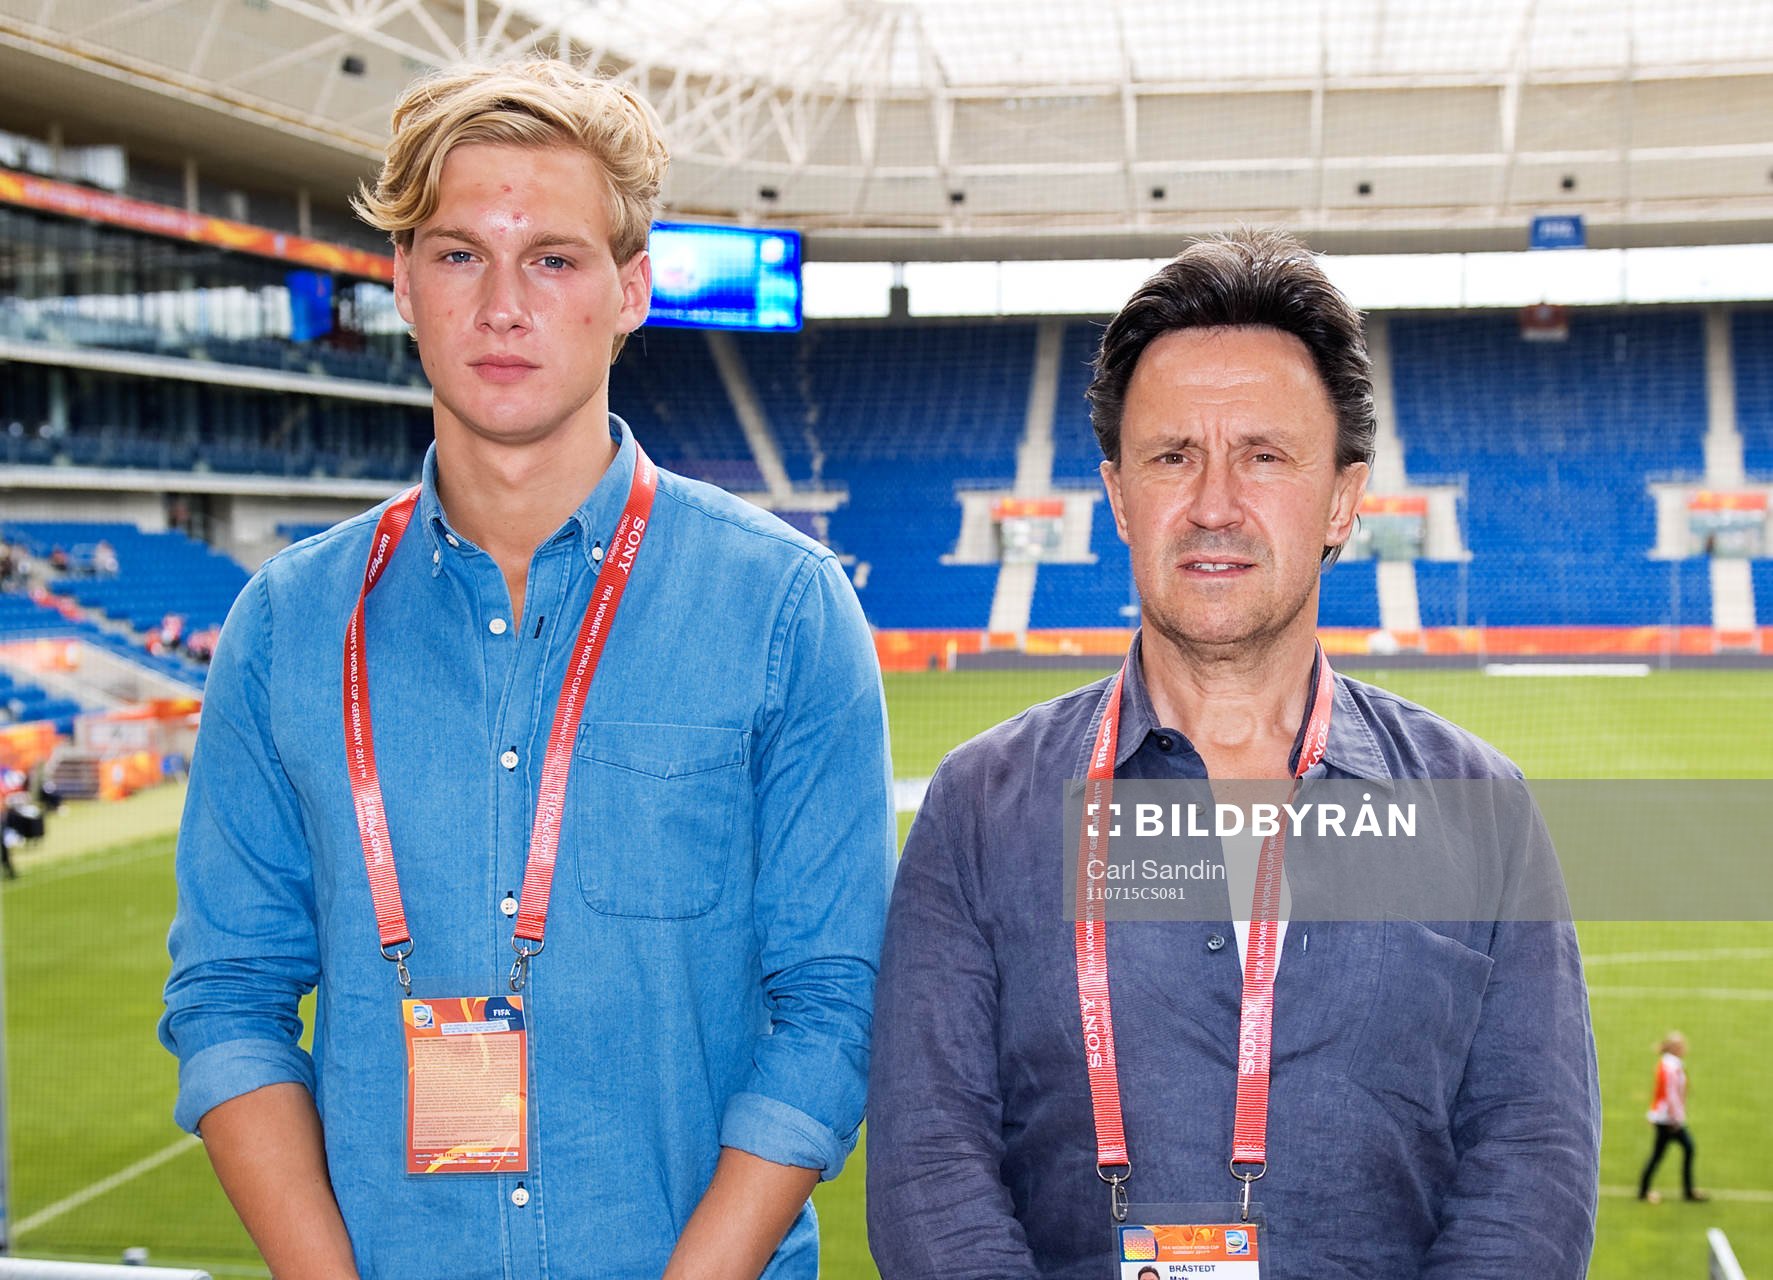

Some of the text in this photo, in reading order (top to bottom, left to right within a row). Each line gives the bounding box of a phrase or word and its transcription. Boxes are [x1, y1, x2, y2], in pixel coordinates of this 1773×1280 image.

[617, 516, 646, 575] SONY
[601, 584, 614, 602] FIFA
[587, 603, 608, 644] WOMEN'S
[350, 651, 358, 683] WORLD
[576, 645, 593, 676] WORLD
[351, 684, 359, 700] CUP
[571, 677, 582, 695] CUP
[351, 702, 363, 746] GERMANY
[559, 695, 576, 742] GERMANY
[1261, 873, 1273, 908] WORLD
[1085, 905, 1095, 954] WOMEN'S
[493, 1008, 511, 1017] FIFA
[1081, 994, 1103, 1069] SONY
[1241, 999, 1257, 1075] SONY
